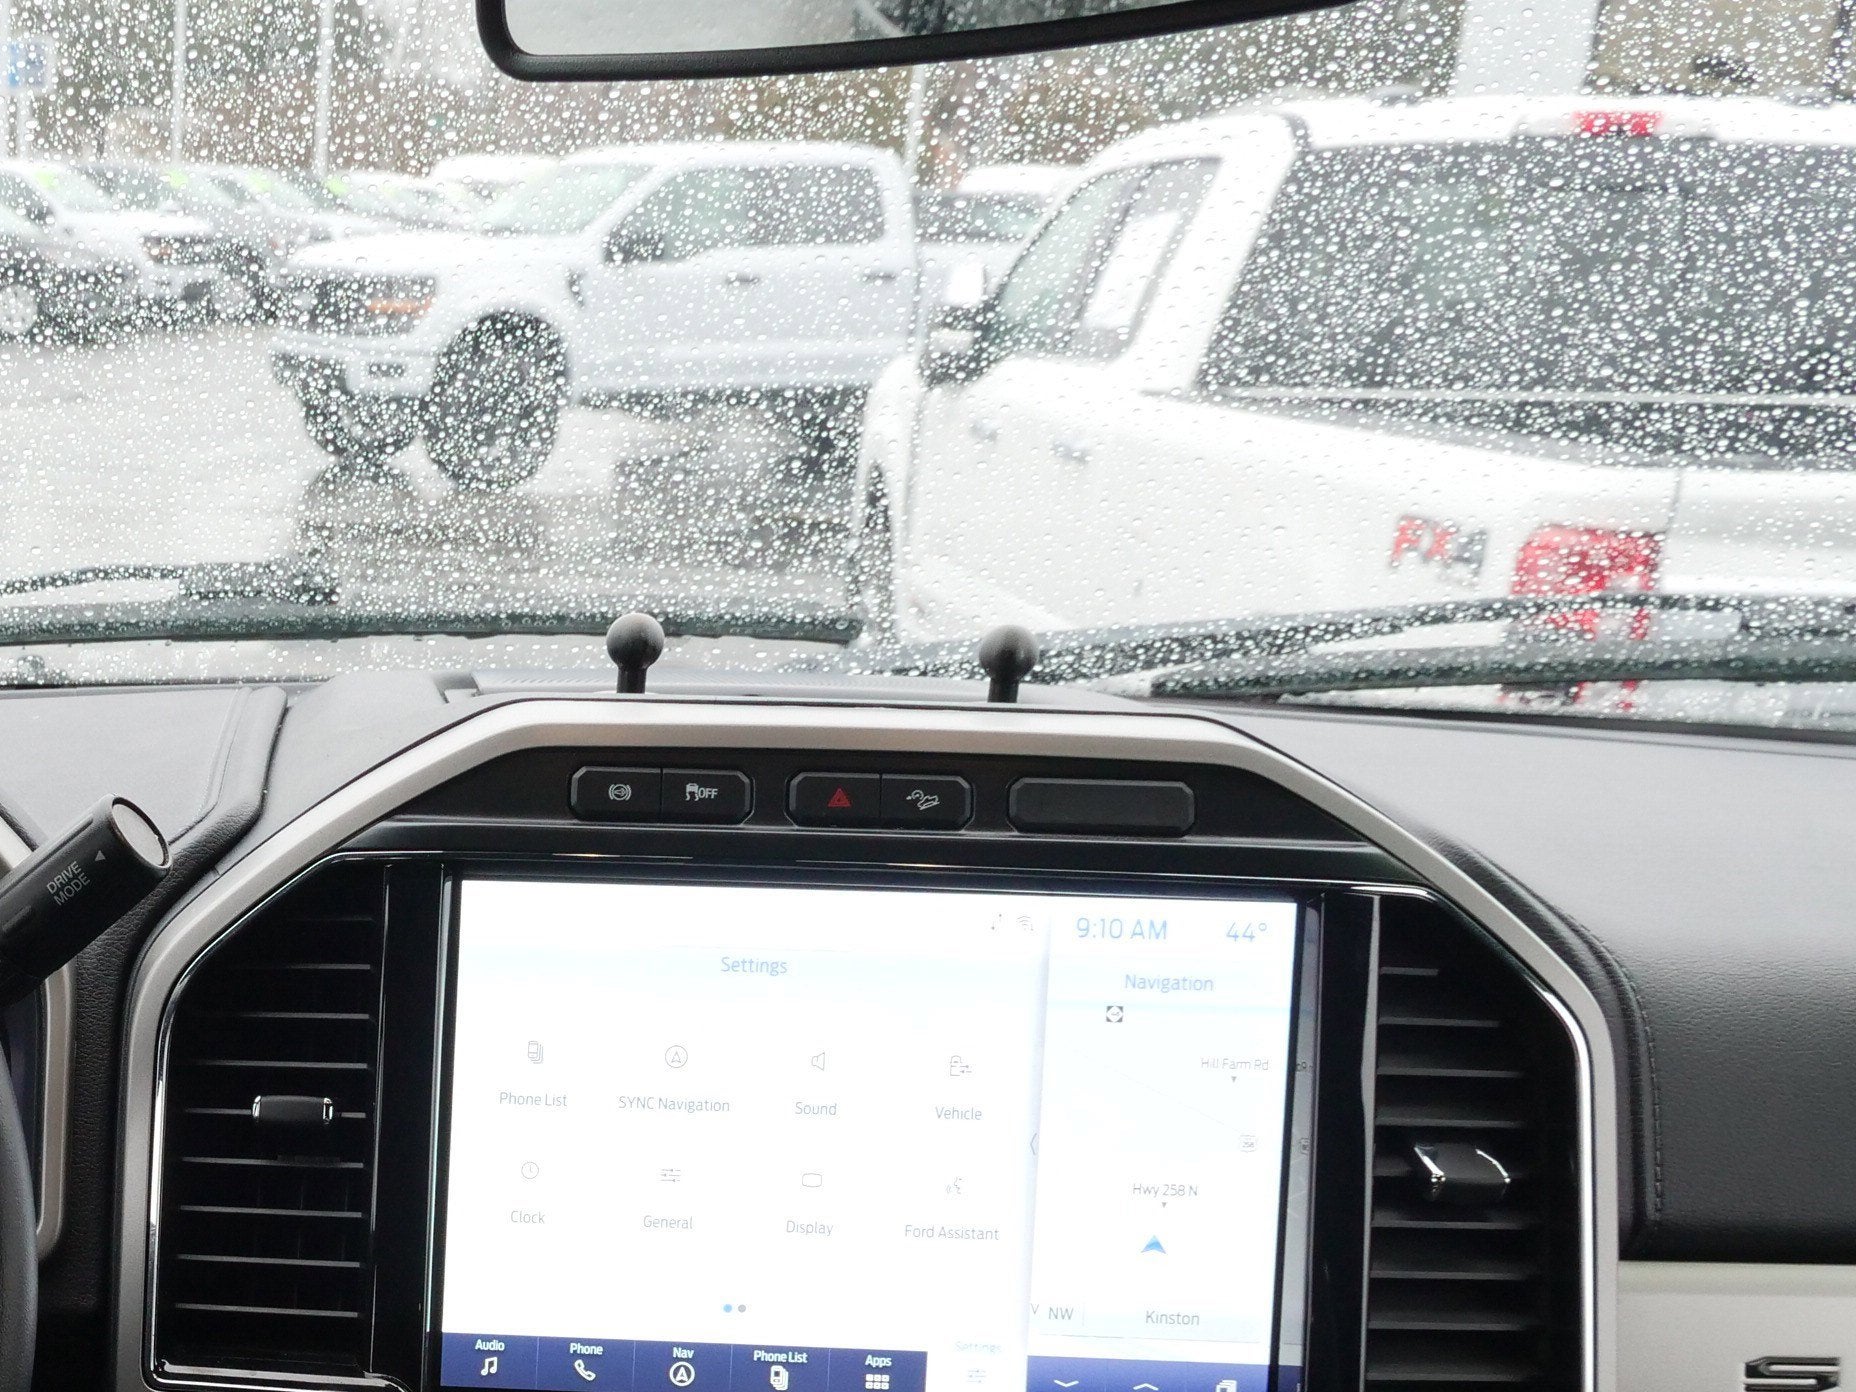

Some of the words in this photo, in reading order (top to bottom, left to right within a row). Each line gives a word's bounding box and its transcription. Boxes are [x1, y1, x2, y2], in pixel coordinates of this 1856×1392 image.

[698, 787, 719, 799] OFF
[46, 861, 82, 894] DRIVE
[54, 873, 91, 906] MODE
[1076, 917, 1124, 938] 9:10
[1130, 920, 1168, 940] AM
[1226, 922, 1269, 942] 44°
[721, 956, 788, 976] Settings
[1125, 973, 1214, 994] Navigation
[1221, 1057, 1251, 1070] Farm
[1254, 1058, 1269, 1071] Rd
[499, 1091, 542, 1106] Phone
[544, 1093, 568, 1107] List
[618, 1096, 655, 1110] SYNC
[658, 1096, 731, 1114] Navigation
[794, 1101, 838, 1116] Sound
[935, 1106, 983, 1121] Vehicle
[1132, 1184, 1159, 1198] Hwy
[1162, 1184, 1185, 1197] 258
[1188, 1185, 1199, 1197] N
[510, 1210, 545, 1224] Clock
[643, 1215, 694, 1230] General
[786, 1220, 834, 1238] Display
[904, 1224, 935, 1239] Ford
[938, 1225, 1000, 1242] Assistant
[1048, 1306, 1074, 1321] NW
[1145, 1310, 1200, 1326] Kinston
[475, 1338, 505, 1351] Audio
[569, 1343, 603, 1356] Phone
[672, 1347, 695, 1359] Nav
[753, 1350, 787, 1363] Phone
[788, 1351, 808, 1364] List
[865, 1354, 892, 1368] Apps
